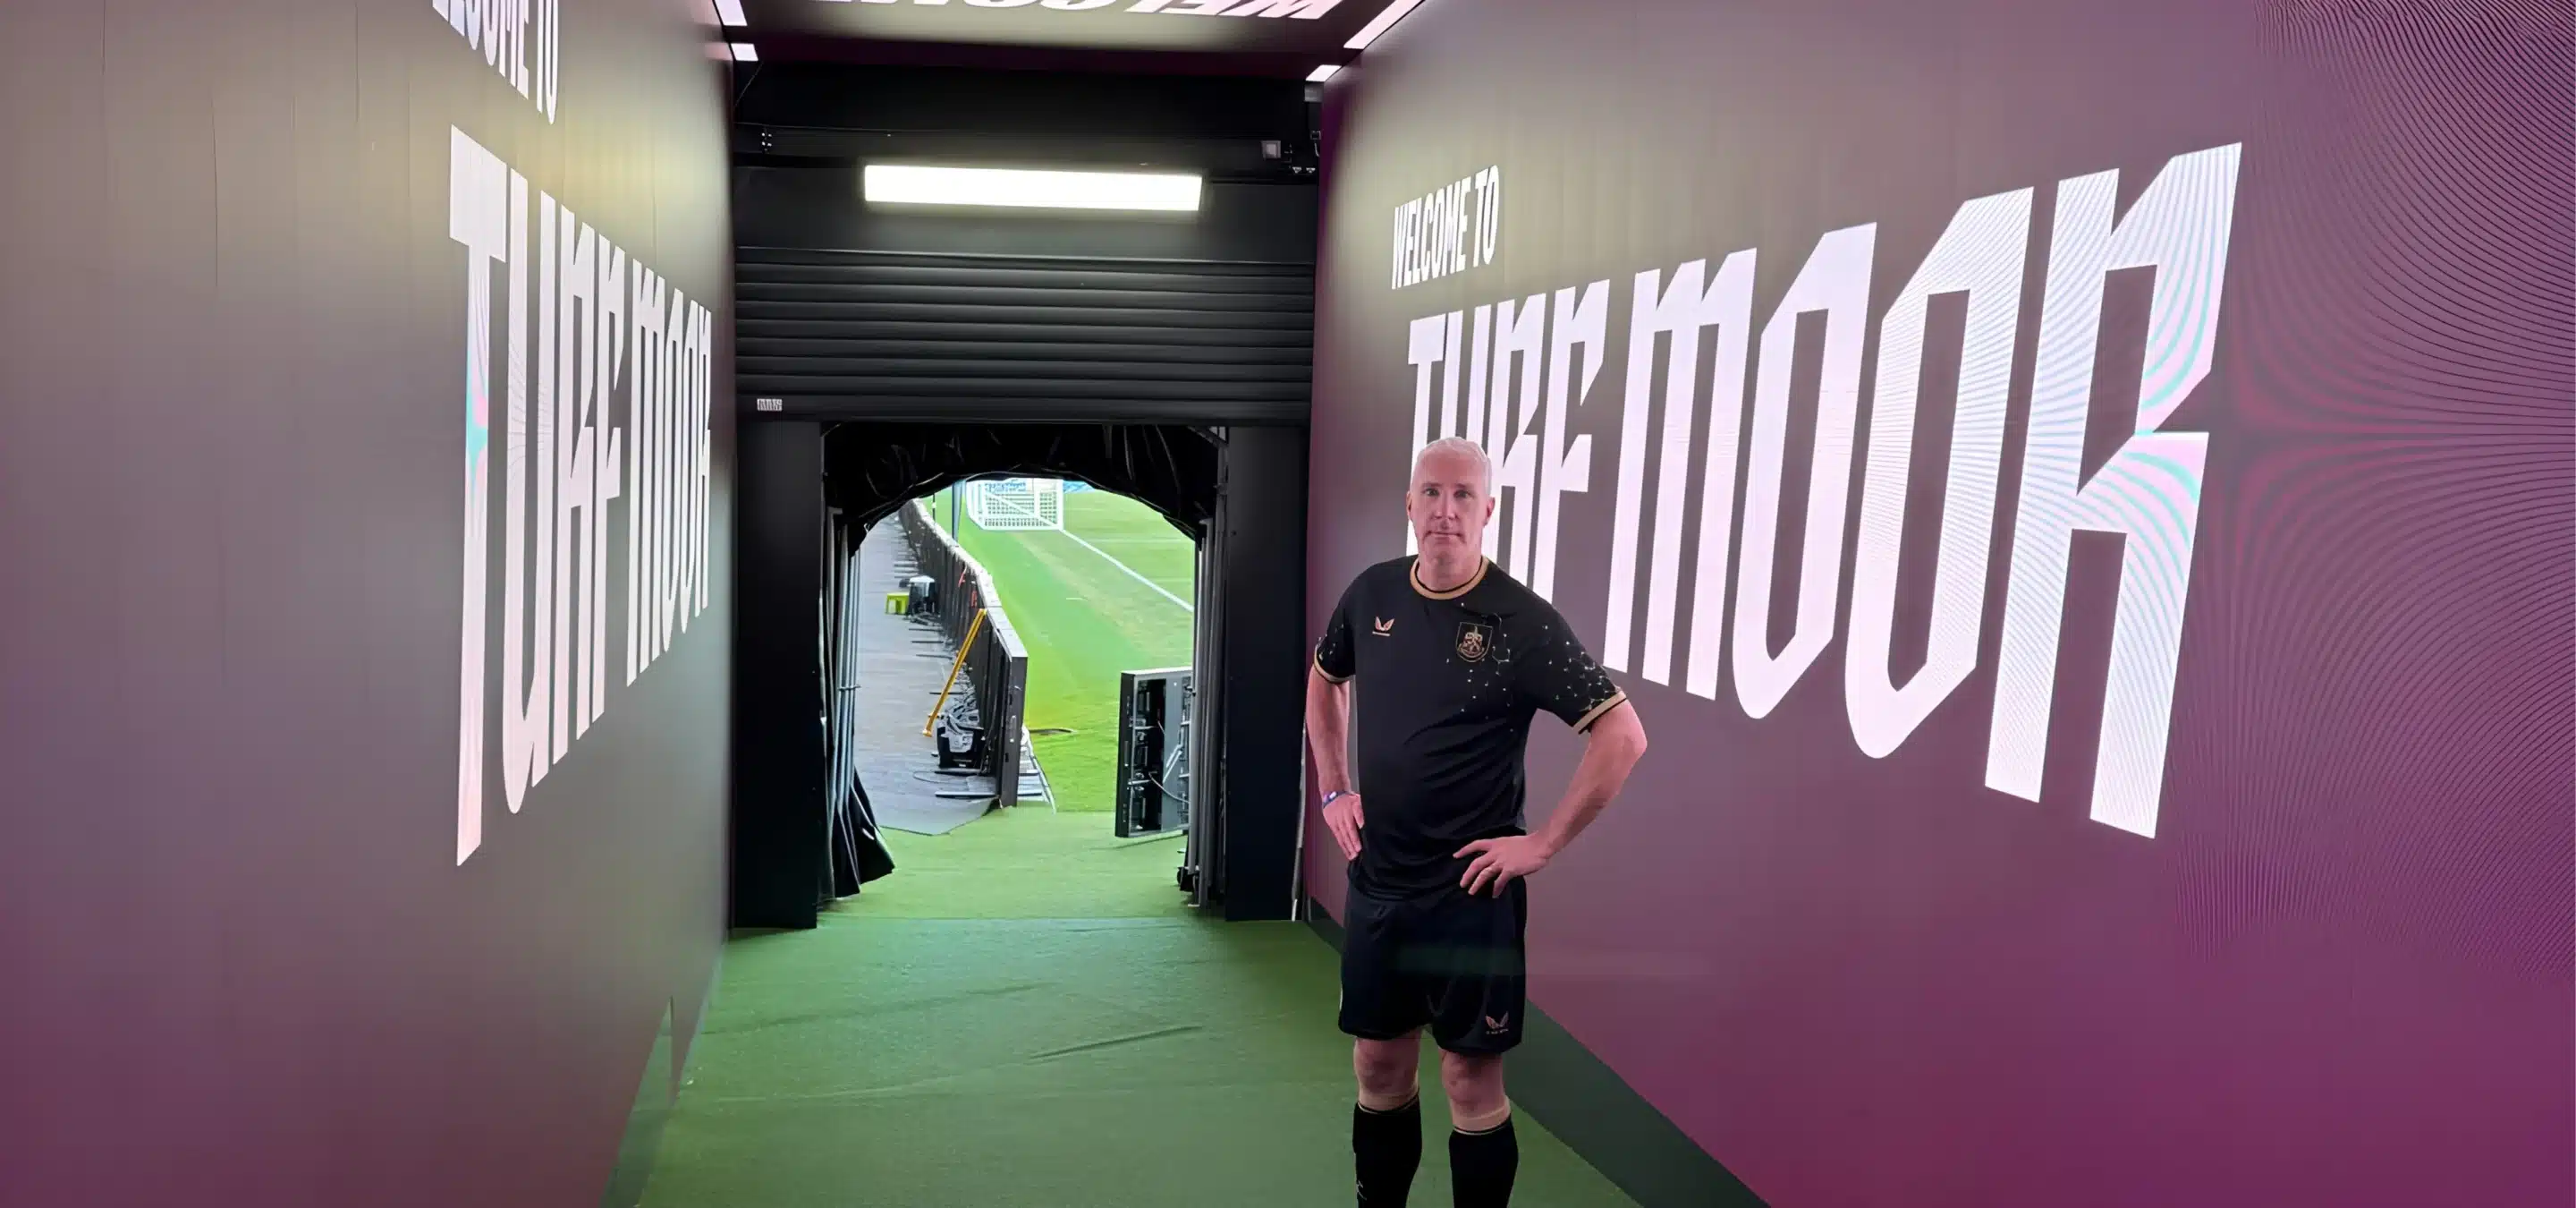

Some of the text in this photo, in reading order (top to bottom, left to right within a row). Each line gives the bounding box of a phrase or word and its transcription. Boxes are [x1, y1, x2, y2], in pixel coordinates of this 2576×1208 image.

[449, 123, 712, 866] TURF MOOR
[1392, 165, 1500, 290] WELCOME TO
[1603, 142, 2241, 839] MOOR
